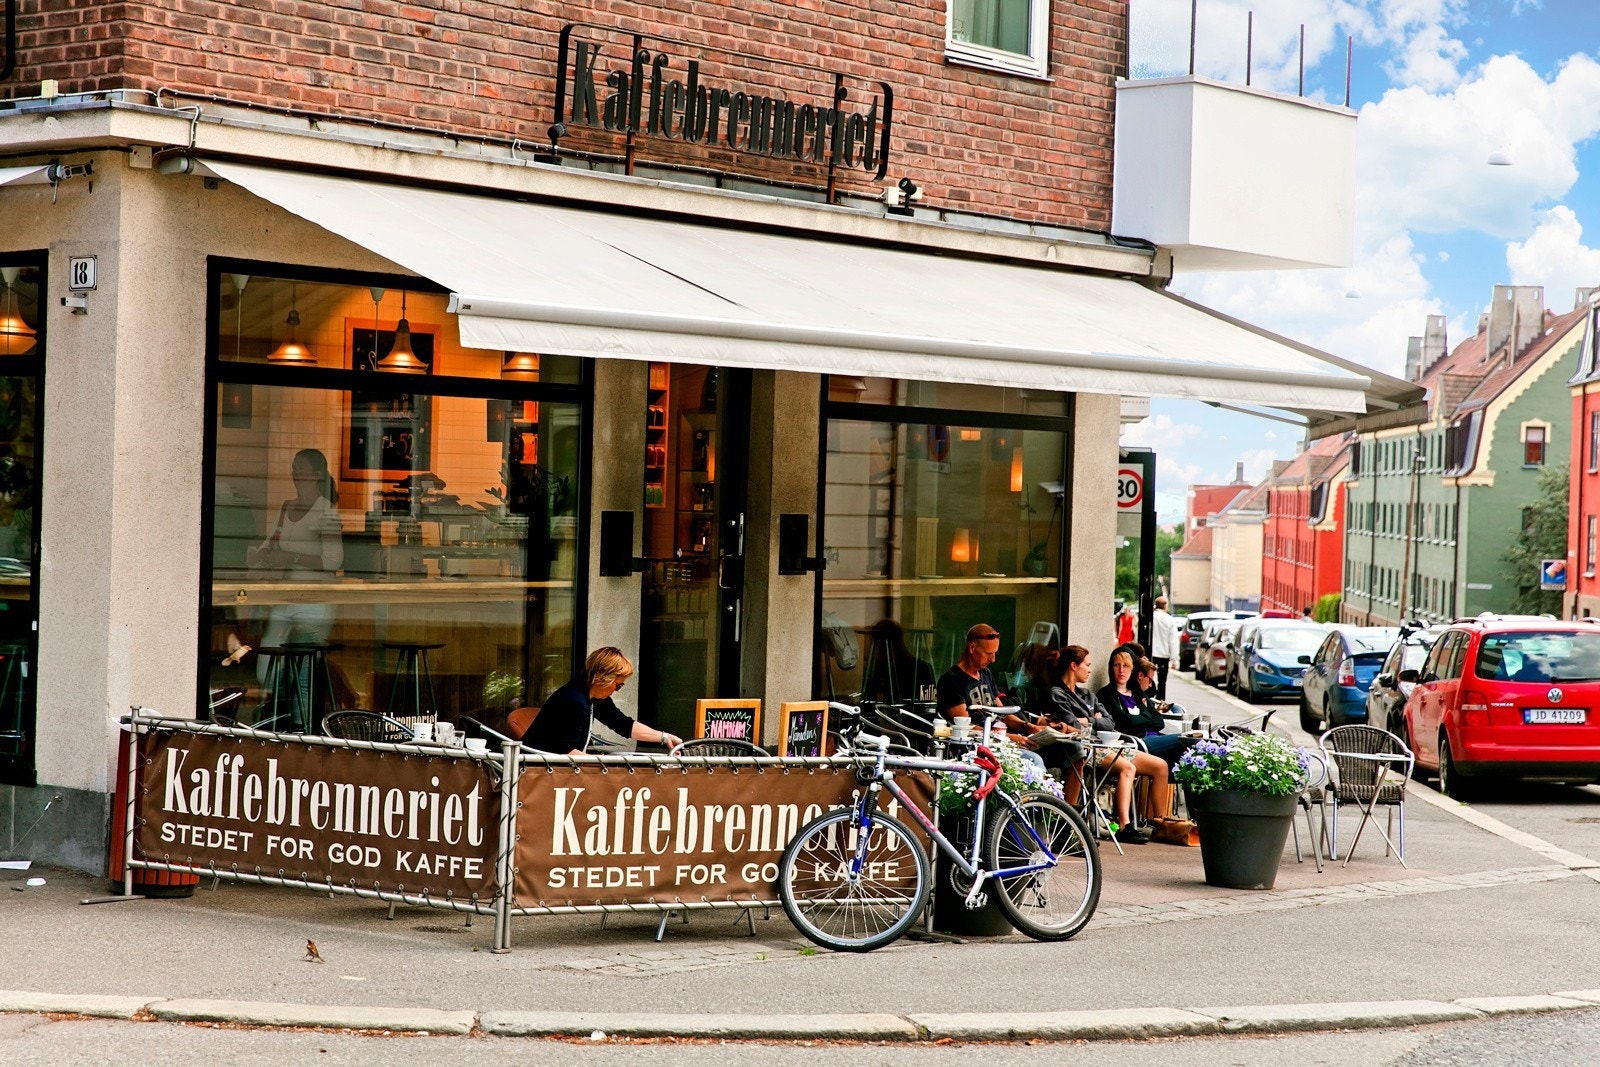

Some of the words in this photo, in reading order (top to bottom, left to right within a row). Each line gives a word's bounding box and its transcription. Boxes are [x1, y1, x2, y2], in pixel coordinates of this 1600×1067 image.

[570, 40, 880, 171] Kaffebrenneriet
[74, 262, 88, 284] 18
[1117, 479, 1138, 498] 30
[1535, 711, 1547, 720] JD
[1551, 711, 1582, 720] 41209
[162, 747, 484, 847] Kaffebrenneriet
[160, 822, 254, 852] STEDET
[266, 835, 314, 860] FOR
[328, 842, 381, 868] GOD
[395, 850, 484, 879] KAFFE
[547, 865, 661, 888] STEDET
[675, 863, 727, 885] FOR
[814, 861, 900, 882] KAFE
